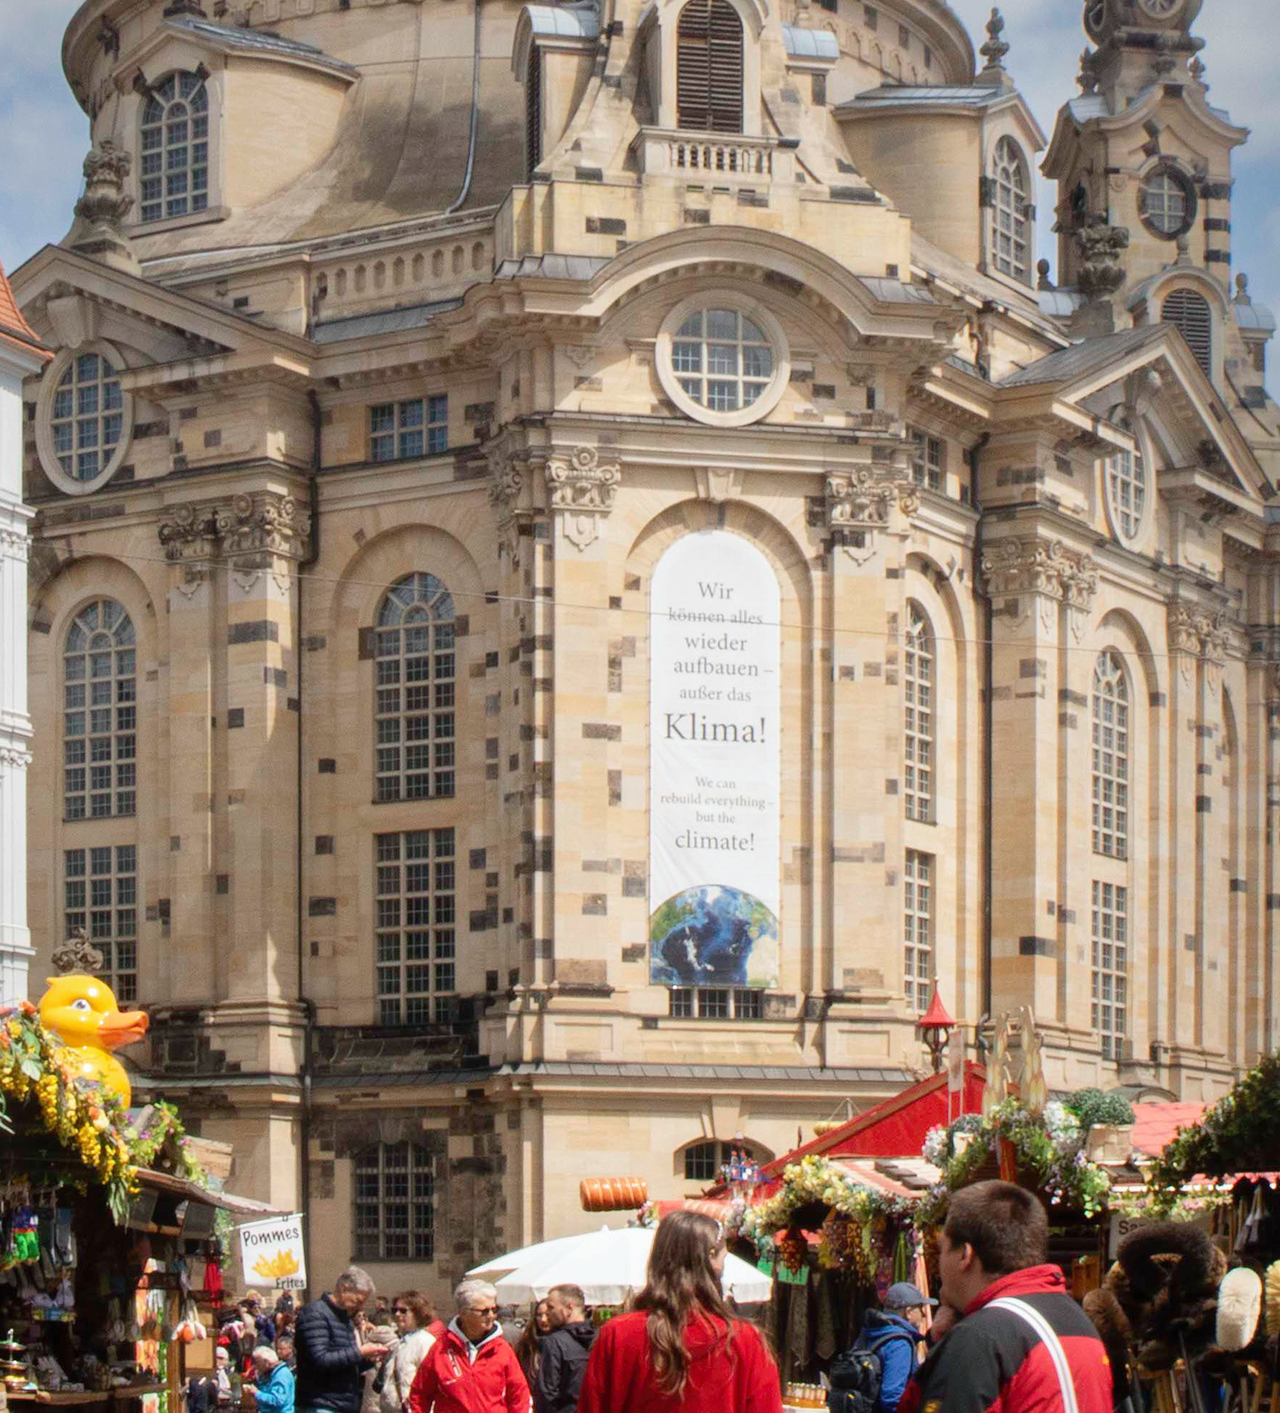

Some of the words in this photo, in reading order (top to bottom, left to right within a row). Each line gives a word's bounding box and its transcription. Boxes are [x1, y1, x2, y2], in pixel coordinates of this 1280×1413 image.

[698, 581, 734, 599] Wir
[668, 606, 725, 623] können
[730, 610, 763, 625] alles
[685, 633, 748, 651] wieder
[673, 656, 759, 677] aufbauen
[679, 685, 723, 701] außer
[727, 687, 752, 702] das
[664, 712, 765, 743] Klima!
[695, 776, 714, 788] We
[716, 778, 737, 789] can
[660, 792, 702, 805] rebuild
[704, 795, 766, 810] everything
[696, 810, 715, 823] but
[717, 812, 736, 824] the
[675, 829, 755, 851] climate!
[243, 1227, 299, 1246] Pommes
[276, 1277, 304, 1289] Frites
